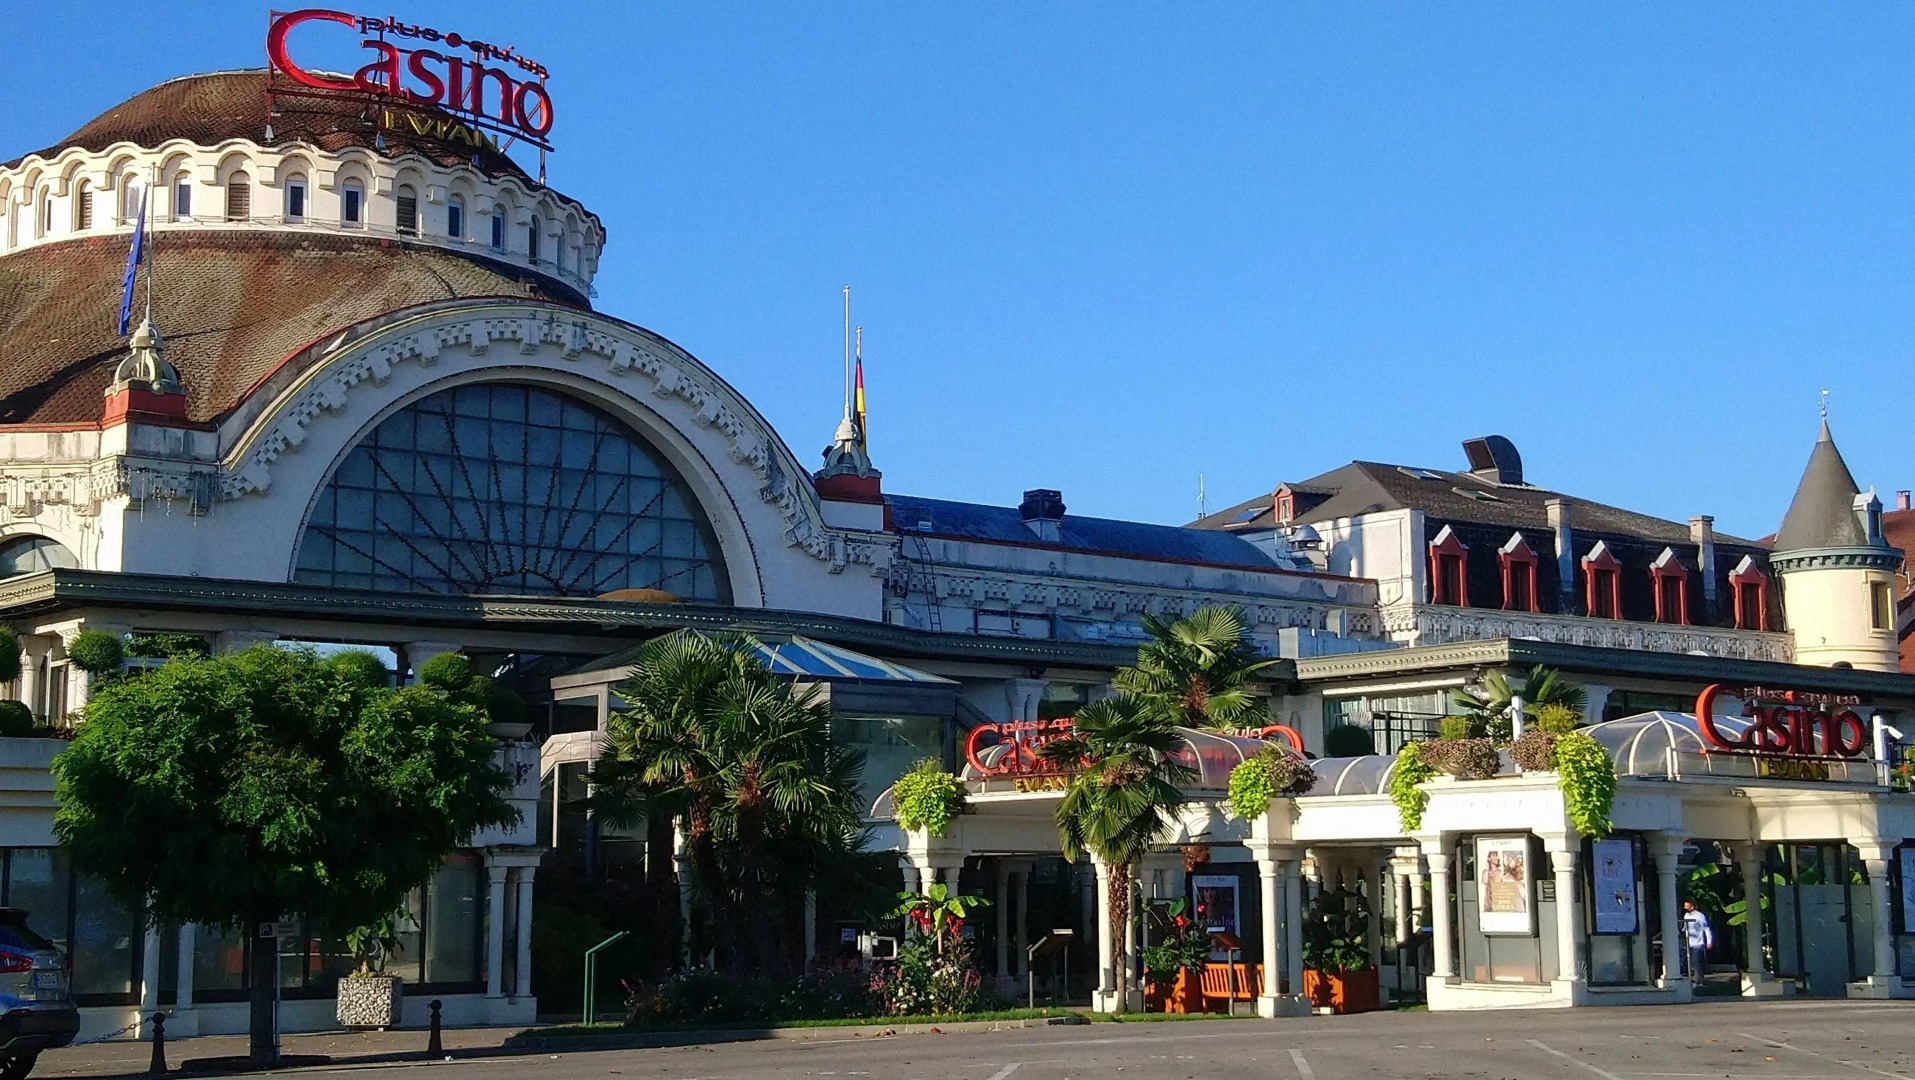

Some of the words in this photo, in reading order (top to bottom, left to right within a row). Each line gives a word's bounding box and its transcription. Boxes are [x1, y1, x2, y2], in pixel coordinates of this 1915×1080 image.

[360, 15, 440, 42] plus
[265, 8, 554, 138] Casino
[1695, 683, 1867, 758] Casino
[1760, 758, 1830, 780] EVIAN
[1013, 776, 1069, 792] EVIAN
